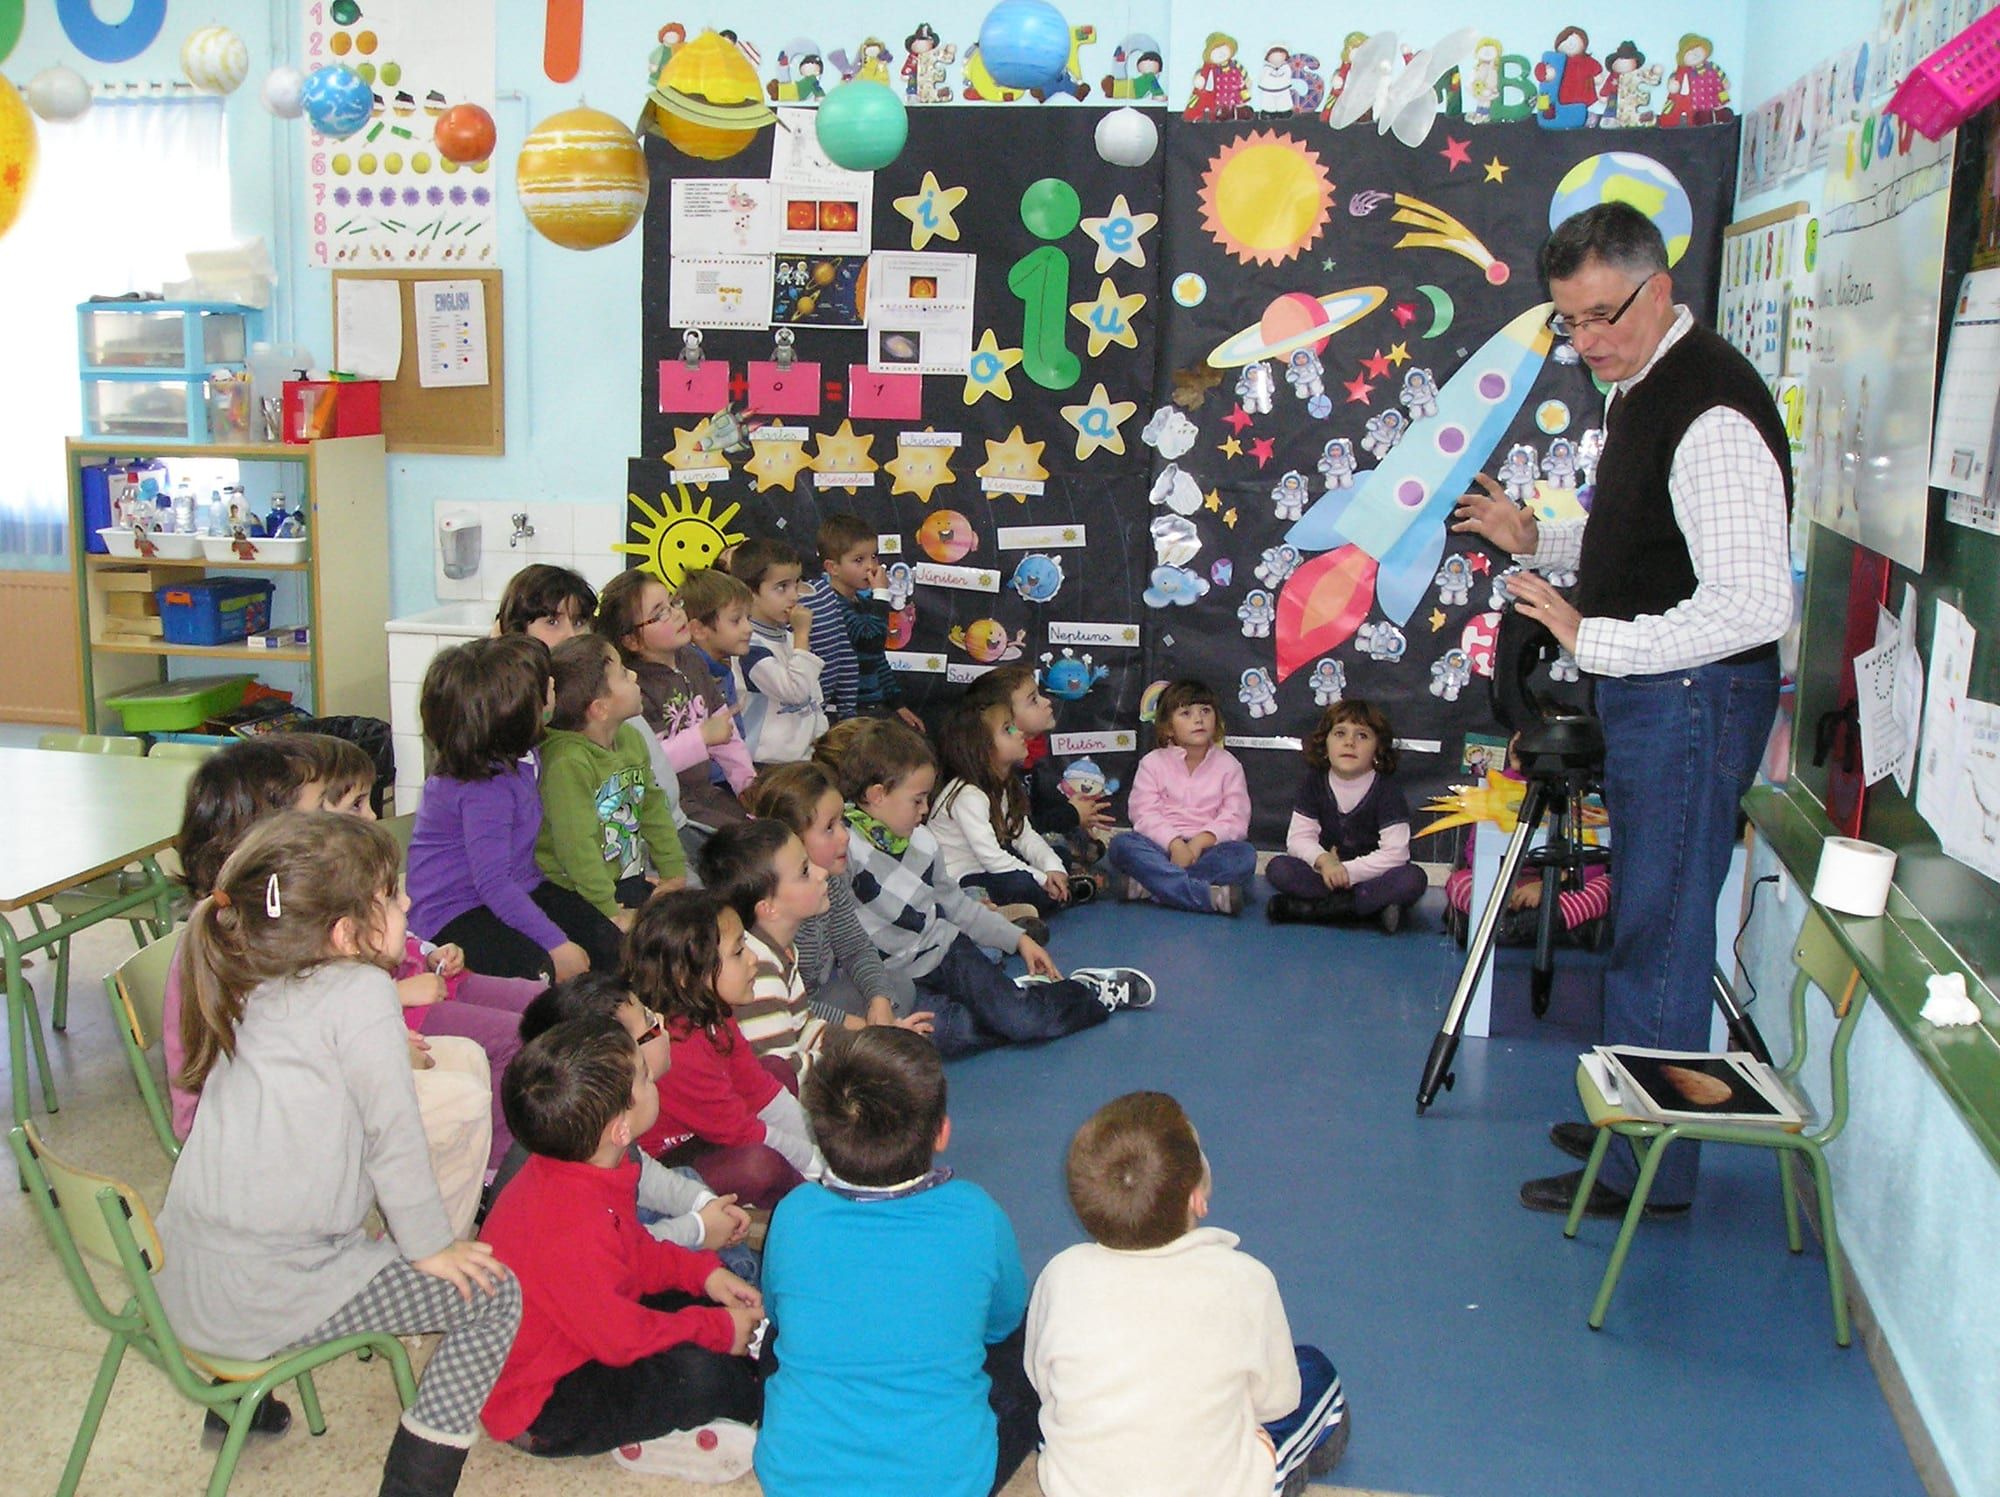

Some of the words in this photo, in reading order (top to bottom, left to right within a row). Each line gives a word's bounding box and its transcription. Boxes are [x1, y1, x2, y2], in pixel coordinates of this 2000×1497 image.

[310, 31, 322, 56] 2
[312, 153, 326, 175] 6
[313, 183, 326, 206] 7
[314, 212, 327, 235] 8
[1099, 217, 1134, 254] e
[315, 241, 328, 264] 9
[434, 292, 470, 312] ENGLISH
[1090, 304, 1125, 335] u
[970, 352, 1004, 384] o
[1078, 407, 1115, 440] a
[904, 434, 952, 446] Jueves
[1050, 626, 1112, 645] Neptuno
[1057, 737, 1106, 750] Plutón
